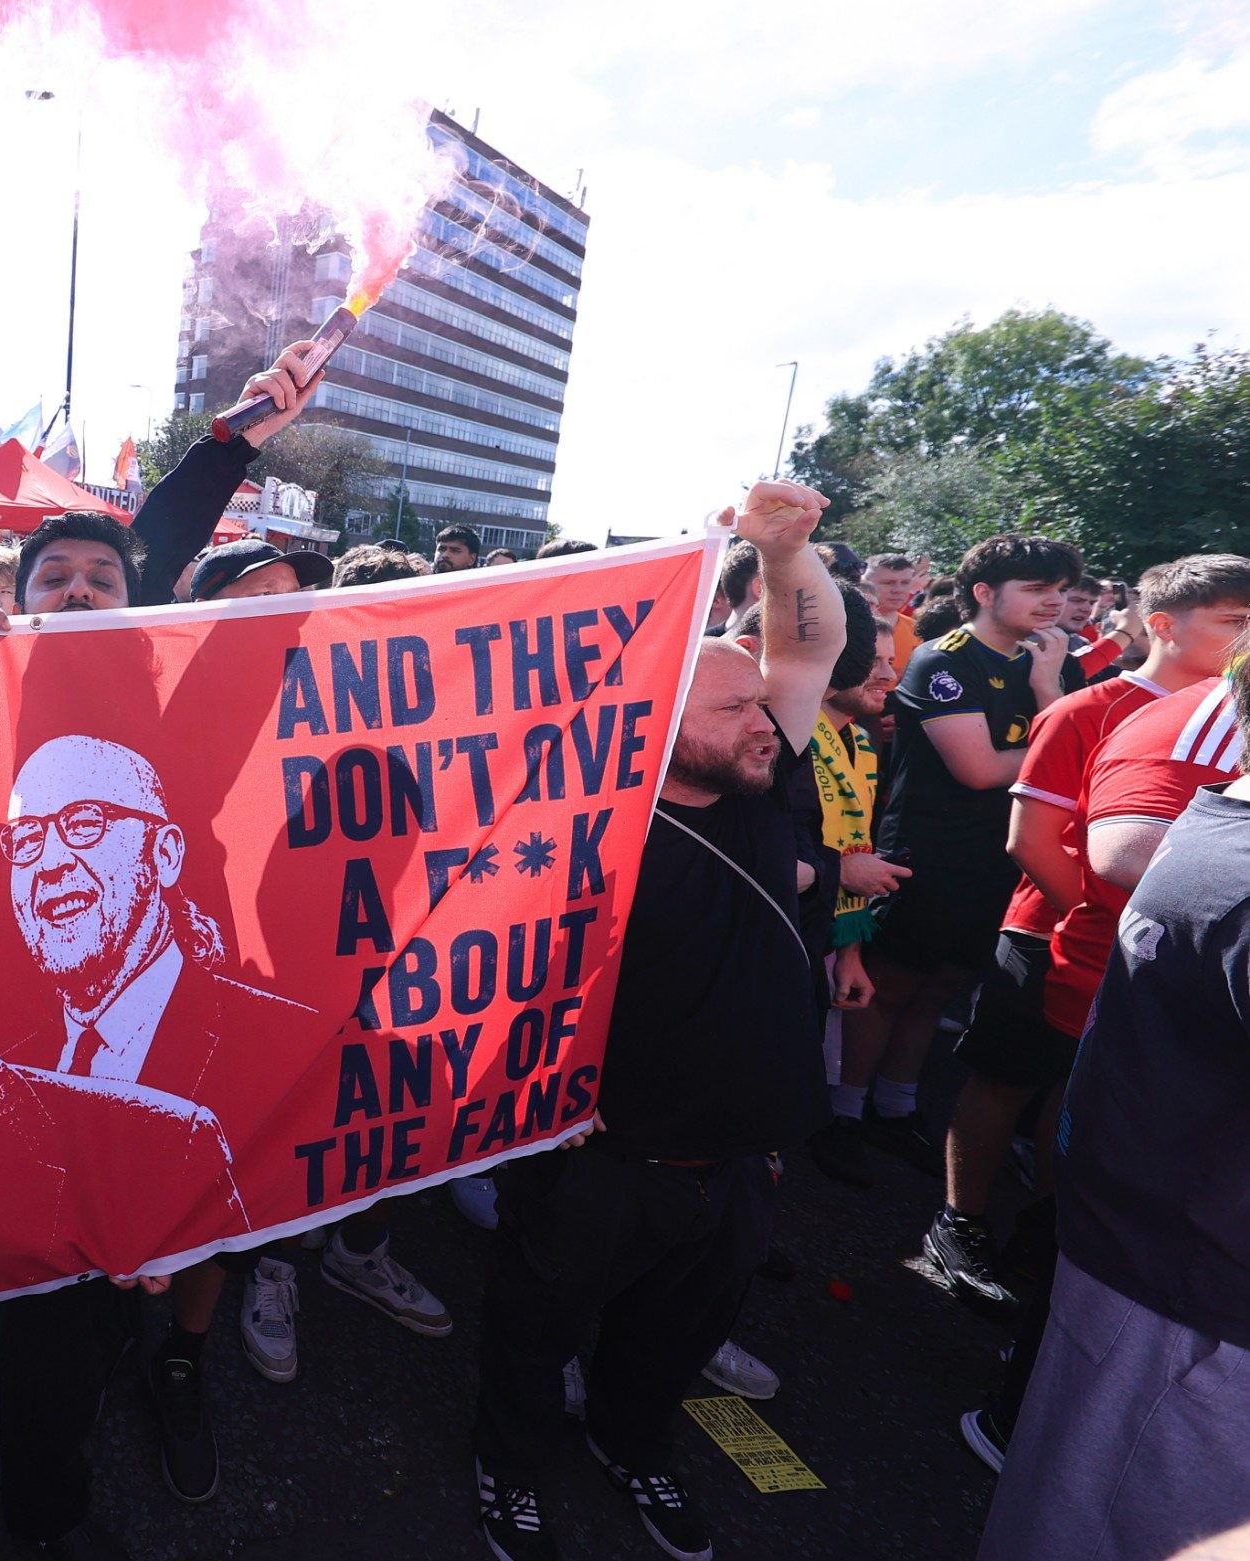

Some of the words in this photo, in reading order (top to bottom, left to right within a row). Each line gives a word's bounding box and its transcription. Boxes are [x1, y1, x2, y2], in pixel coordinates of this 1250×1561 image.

[276, 635, 435, 740] AND
[455, 599, 654, 716] THEY
[281, 732, 499, 849] DON'T
[815, 763, 834, 803] GOLD
[817, 722, 841, 757] SOLD
[336, 858, 395, 956] A
[339, 907, 598, 1035] ABOUT
[334, 1023, 483, 1128] ANY
[506, 997, 583, 1081] OF
[294, 1116, 426, 1207] THE
[446, 1064, 598, 1163] FANS
